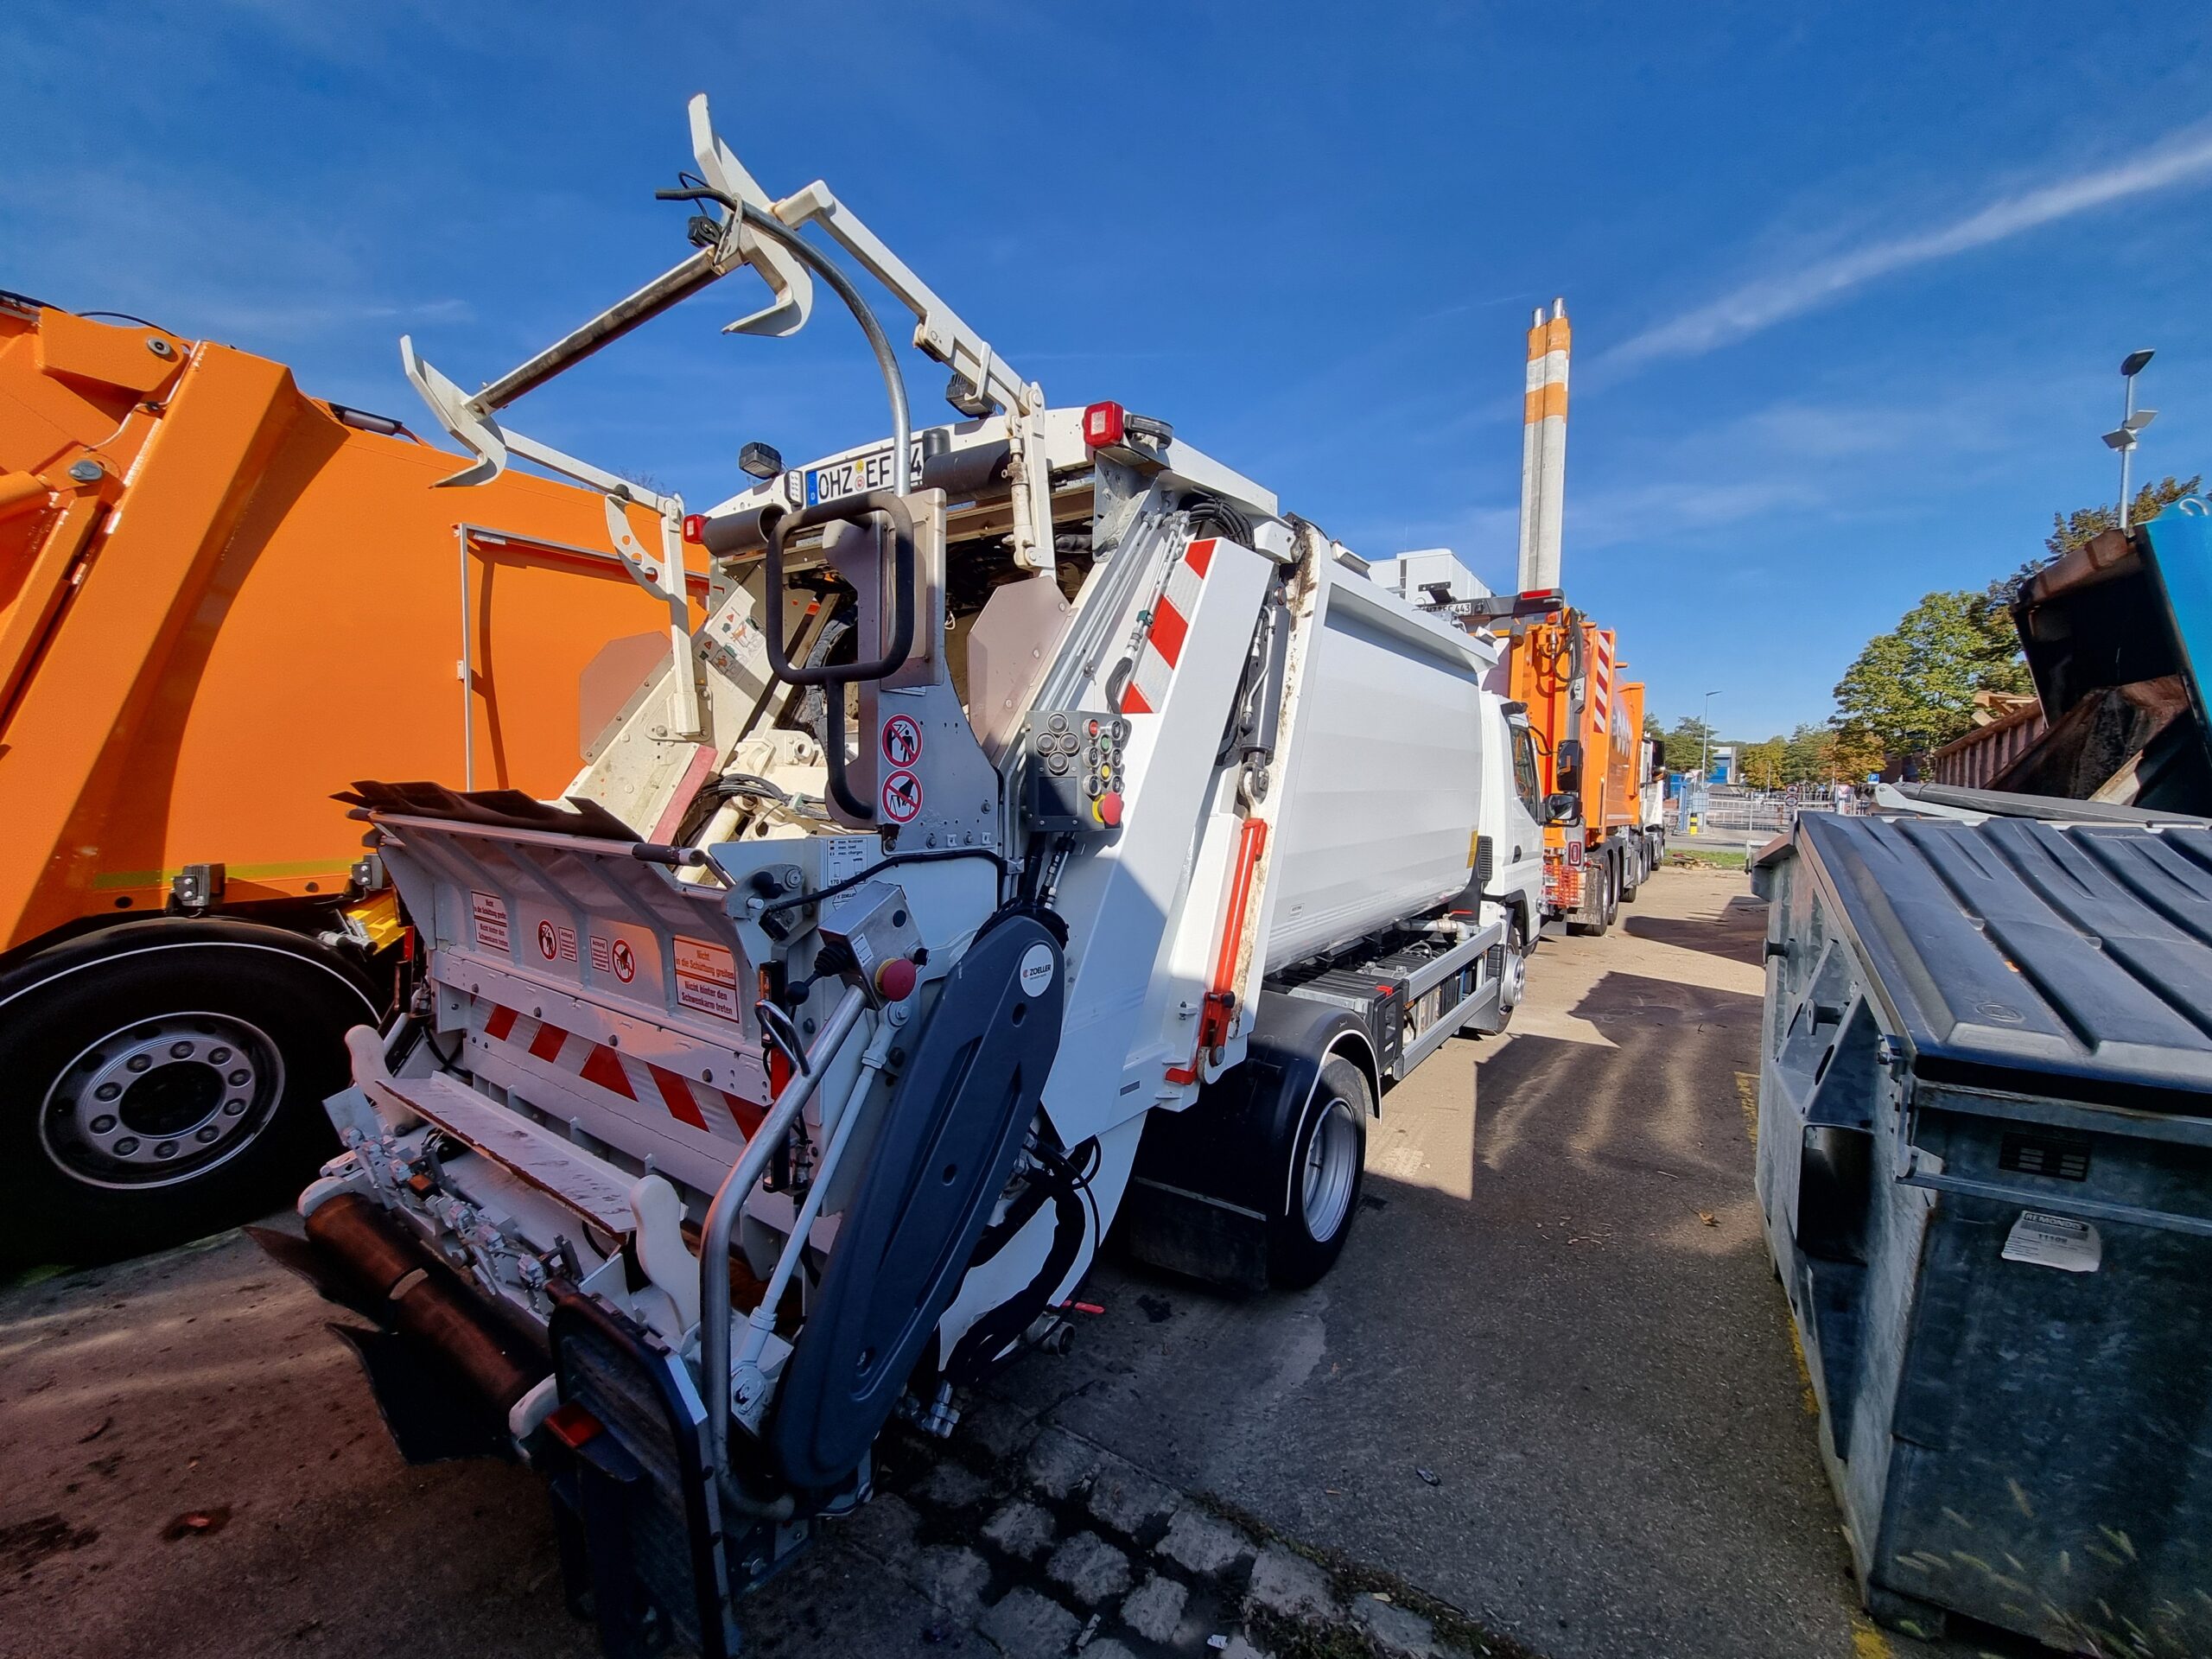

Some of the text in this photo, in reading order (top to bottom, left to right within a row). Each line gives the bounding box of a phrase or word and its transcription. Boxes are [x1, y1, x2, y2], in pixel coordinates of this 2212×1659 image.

[818, 465, 853, 499] OHZ
[866, 455, 891, 488] EF
[1455, 604, 1471, 613] 443
[1029, 964, 1051, 976] ZOELLER
[684, 981, 728, 1001] Nicht hinter den
[681, 991, 734, 1015] Schwenkarm treten
[2024, 1213, 2083, 1230] REMONDIS
